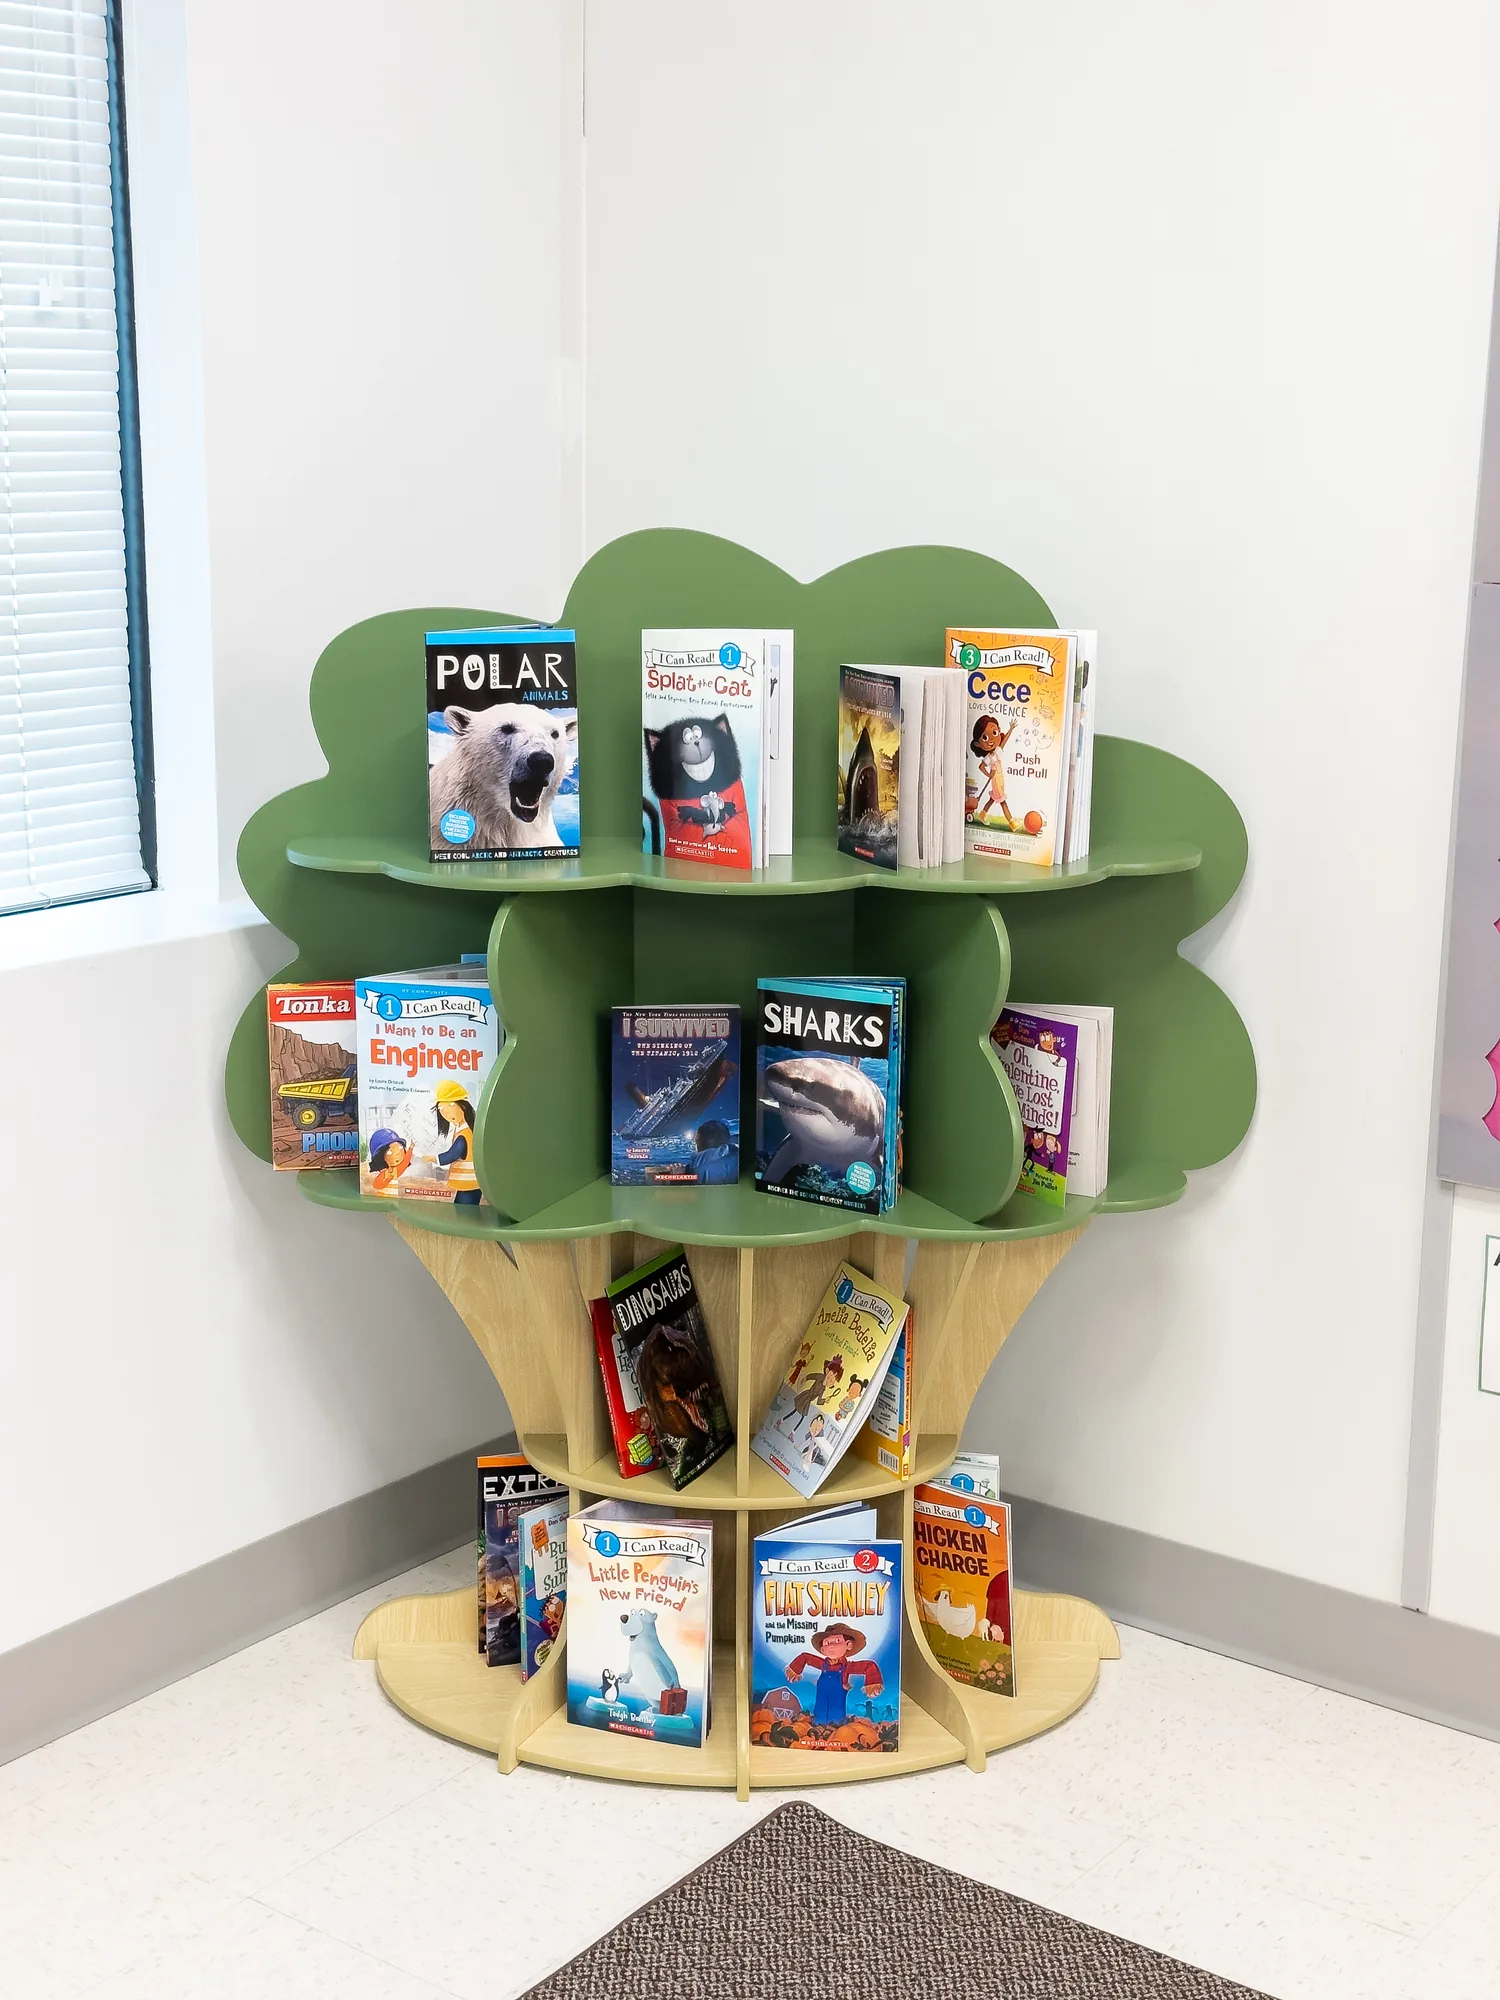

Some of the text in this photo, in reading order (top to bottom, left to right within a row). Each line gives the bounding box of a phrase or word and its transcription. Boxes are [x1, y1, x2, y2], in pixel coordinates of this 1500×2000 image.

[659, 649, 733, 665] I Can Read! 1
[965, 649, 1045, 666] 3 I Can Read!
[437, 653, 568, 690] POLAR
[647, 669, 752, 697] Splat the Cat
[967, 671, 1031, 703] Cece
[522, 690, 568, 701] ANIMALS
[988, 703, 1028, 718] SCIENCE
[1015, 752, 1041, 765] Push
[1006, 765, 1048, 779] and Pull
[276, 996, 350, 1015] Tonka
[386, 999, 476, 1015] 1 I Can Read!
[375, 1022, 477, 1039] I Want to Be an
[622, 1018, 730, 1038] I SURVIVED
[763, 1002, 883, 1048] SHARKS
[370, 1038, 483, 1078] Engineer
[1013, 1046, 1032, 1068] Oh,
[1026, 1086, 1054, 1108] Lost
[410, 1189, 451, 1197] SCHOLASTIC
[615, 1263, 692, 1331] DINOSAURS
[840, 1285, 890, 1319] 1 I Can Read!
[816, 1306, 849, 1326] Amelia
[848, 1312, 877, 1363] Bedelia
[483, 1474, 561, 1499] EXTR
[914, 1501, 977, 1522] Can Read! 1
[603, 1536, 694, 1553] 1 I Can Read!
[914, 1521, 988, 1555] HICKEN
[778, 1561, 783, 1572] I
[786, 1561, 811, 1573] Can
[814, 1558, 849, 1571] Read!
[861, 1554, 871, 1567] 2
[916, 1546, 990, 1577] CHARGE
[587, 1561, 699, 1595] Little Penguin's
[599, 1587, 688, 1612] New Friend
[763, 1579, 891, 1618] FLAT STANLEY
[765, 1618, 818, 1632] and the Missing
[765, 1631, 806, 1645] Pumpkins
[615, 1723, 654, 1736] SCHOLASTIC
[629, 1712, 657, 1727] Bentley
